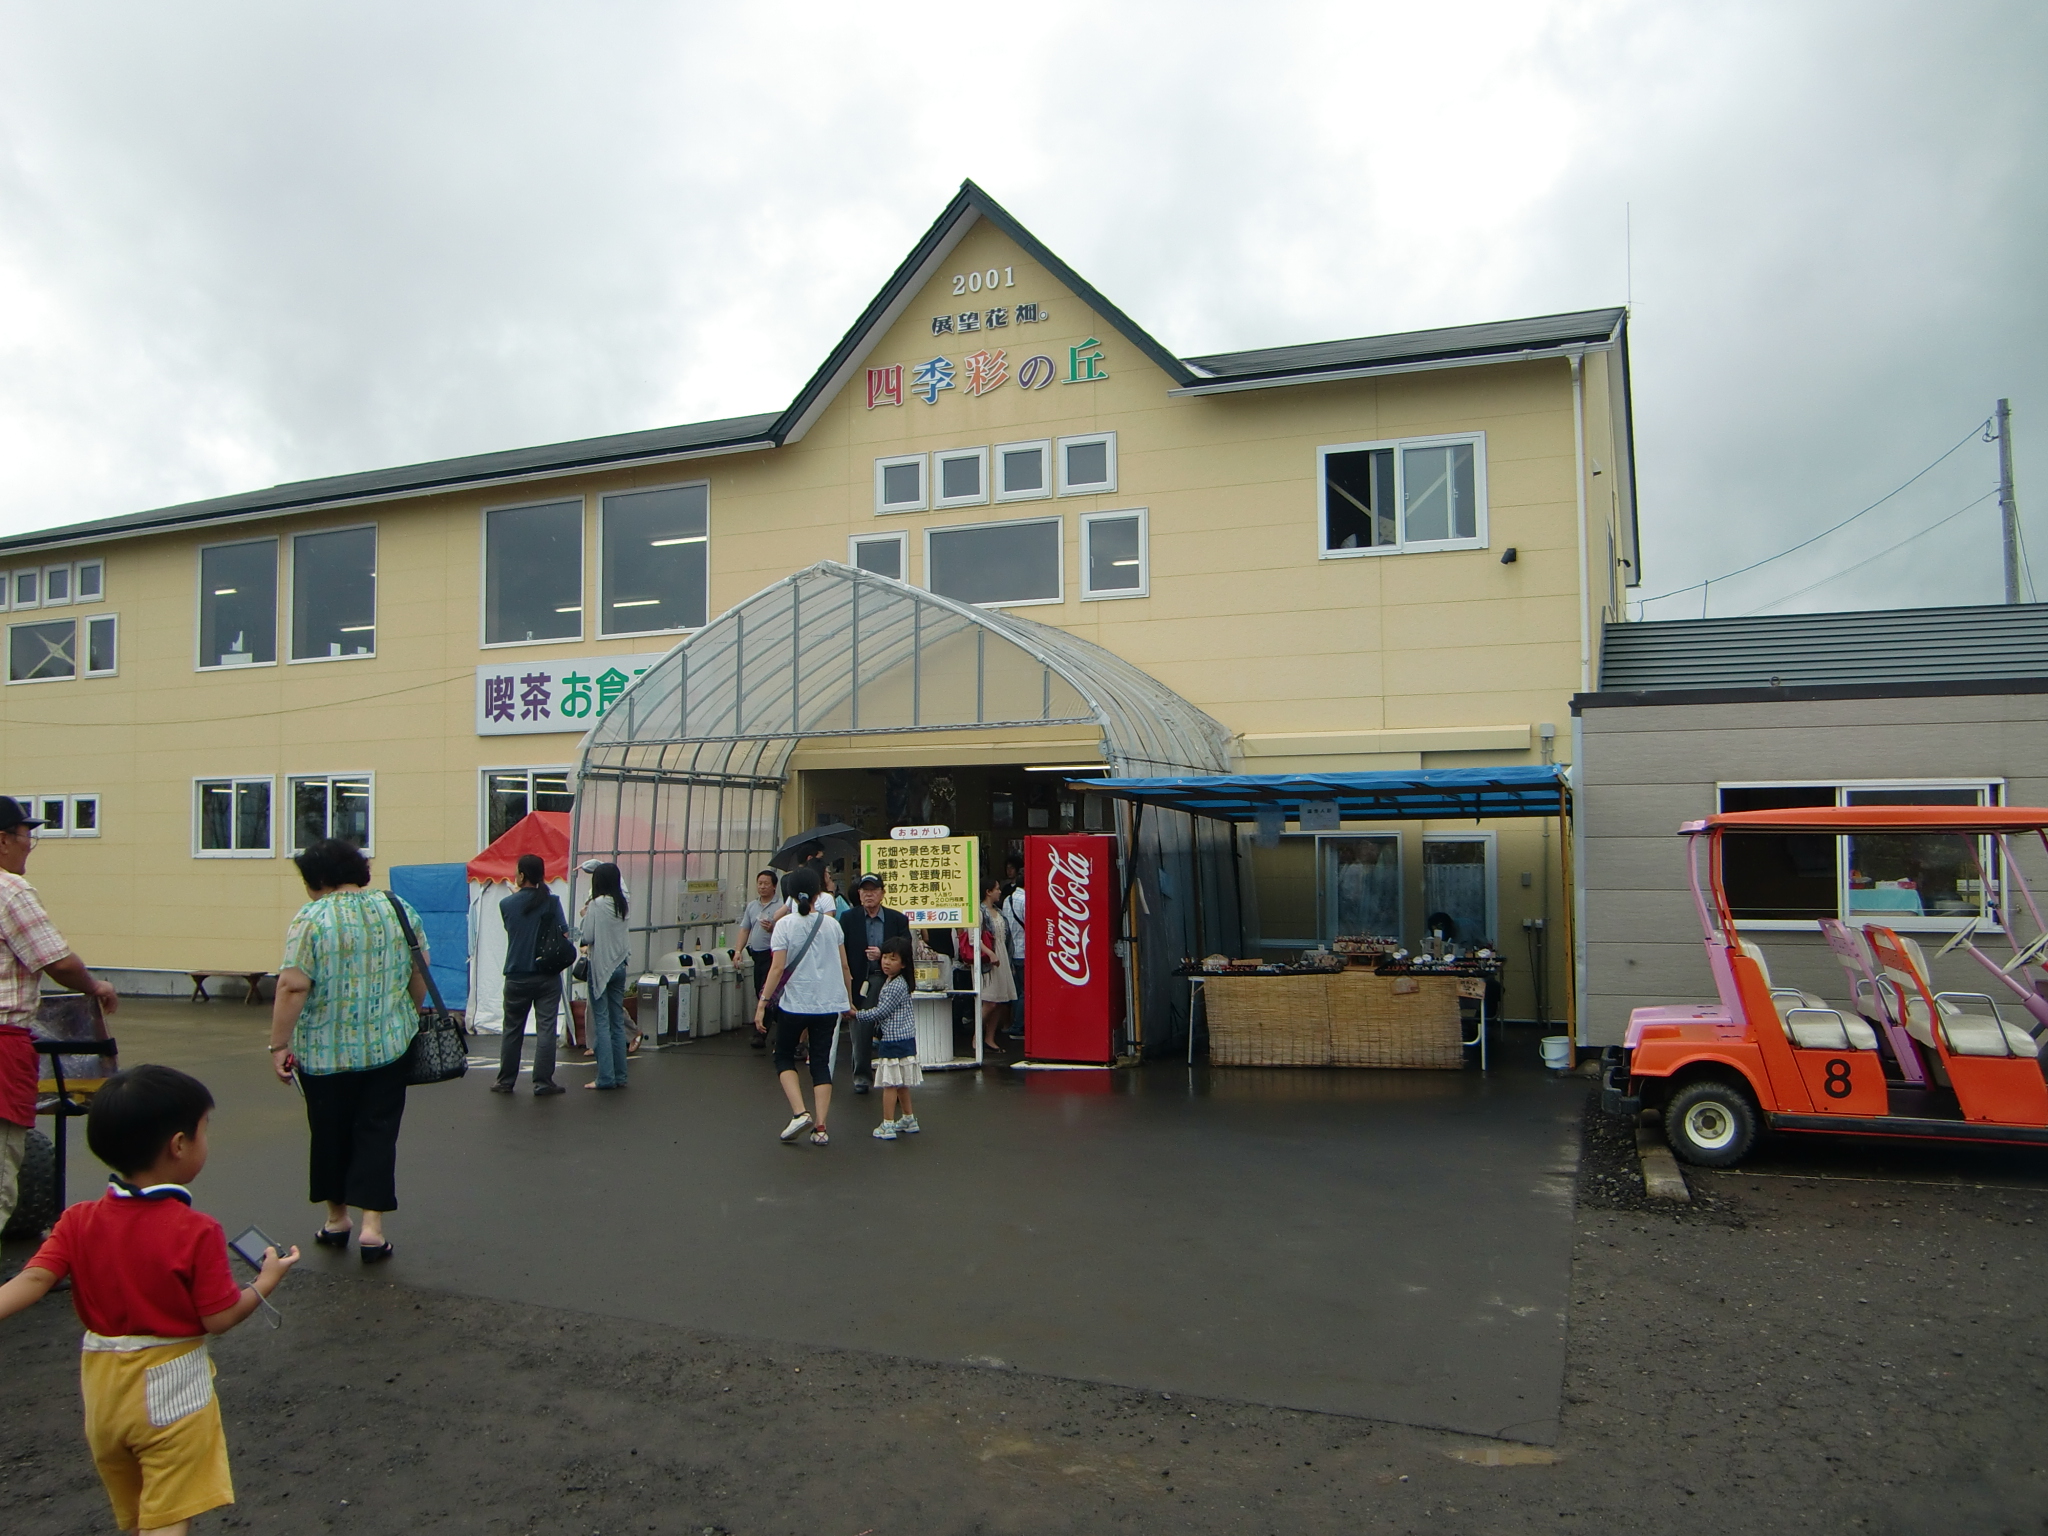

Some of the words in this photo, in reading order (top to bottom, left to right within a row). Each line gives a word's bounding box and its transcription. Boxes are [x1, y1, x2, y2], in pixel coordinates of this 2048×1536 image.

[952, 266, 1015, 296] 2001
[866, 337, 1108, 410] 四季彩の丘
[898, 827, 941, 837] おねがい
[877, 844, 962, 857] 花畑や景色を見て
[877, 857, 959, 870] 感動された方は、
[884, 881, 952, 893] 協力をお願い
[905, 910, 959, 921] 四季彩の丘
[1048, 844, 1090, 986] Coca-Cola
[1046, 918, 1055, 947] Enjoy!
[1824, 1059, 1852, 1098] 8
